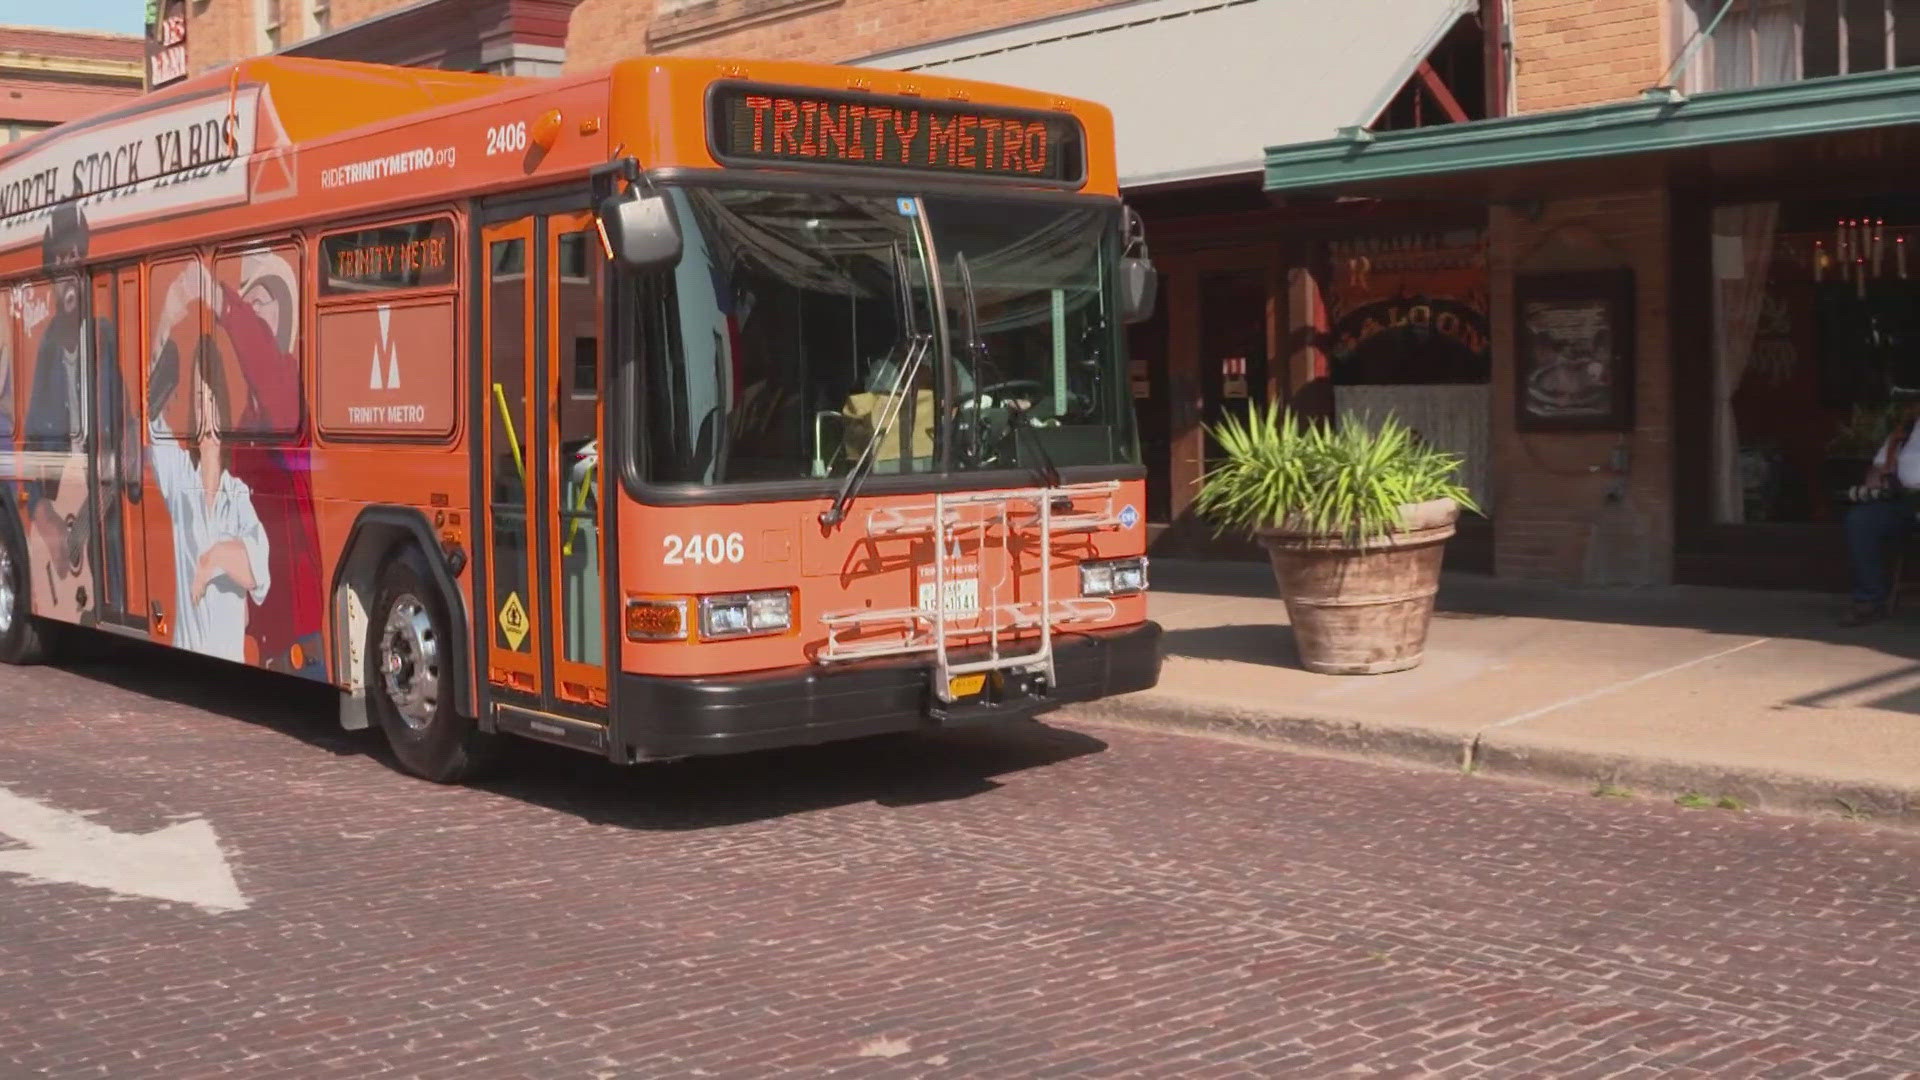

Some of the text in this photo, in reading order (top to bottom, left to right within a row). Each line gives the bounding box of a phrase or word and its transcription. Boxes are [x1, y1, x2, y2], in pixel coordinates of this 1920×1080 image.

[486, 121, 527, 156] 2406
[745, 96, 1048, 173] TRINITY METRO
[71, 140, 143, 207] STOCK
[154, 112, 240, 187] YARDS
[321, 145, 456, 189] RIDETRINITYMETRO.org
[337, 245, 395, 277] TRINITY
[348, 404, 425, 425] TRINITY METRO
[662, 531, 745, 566] 2406
